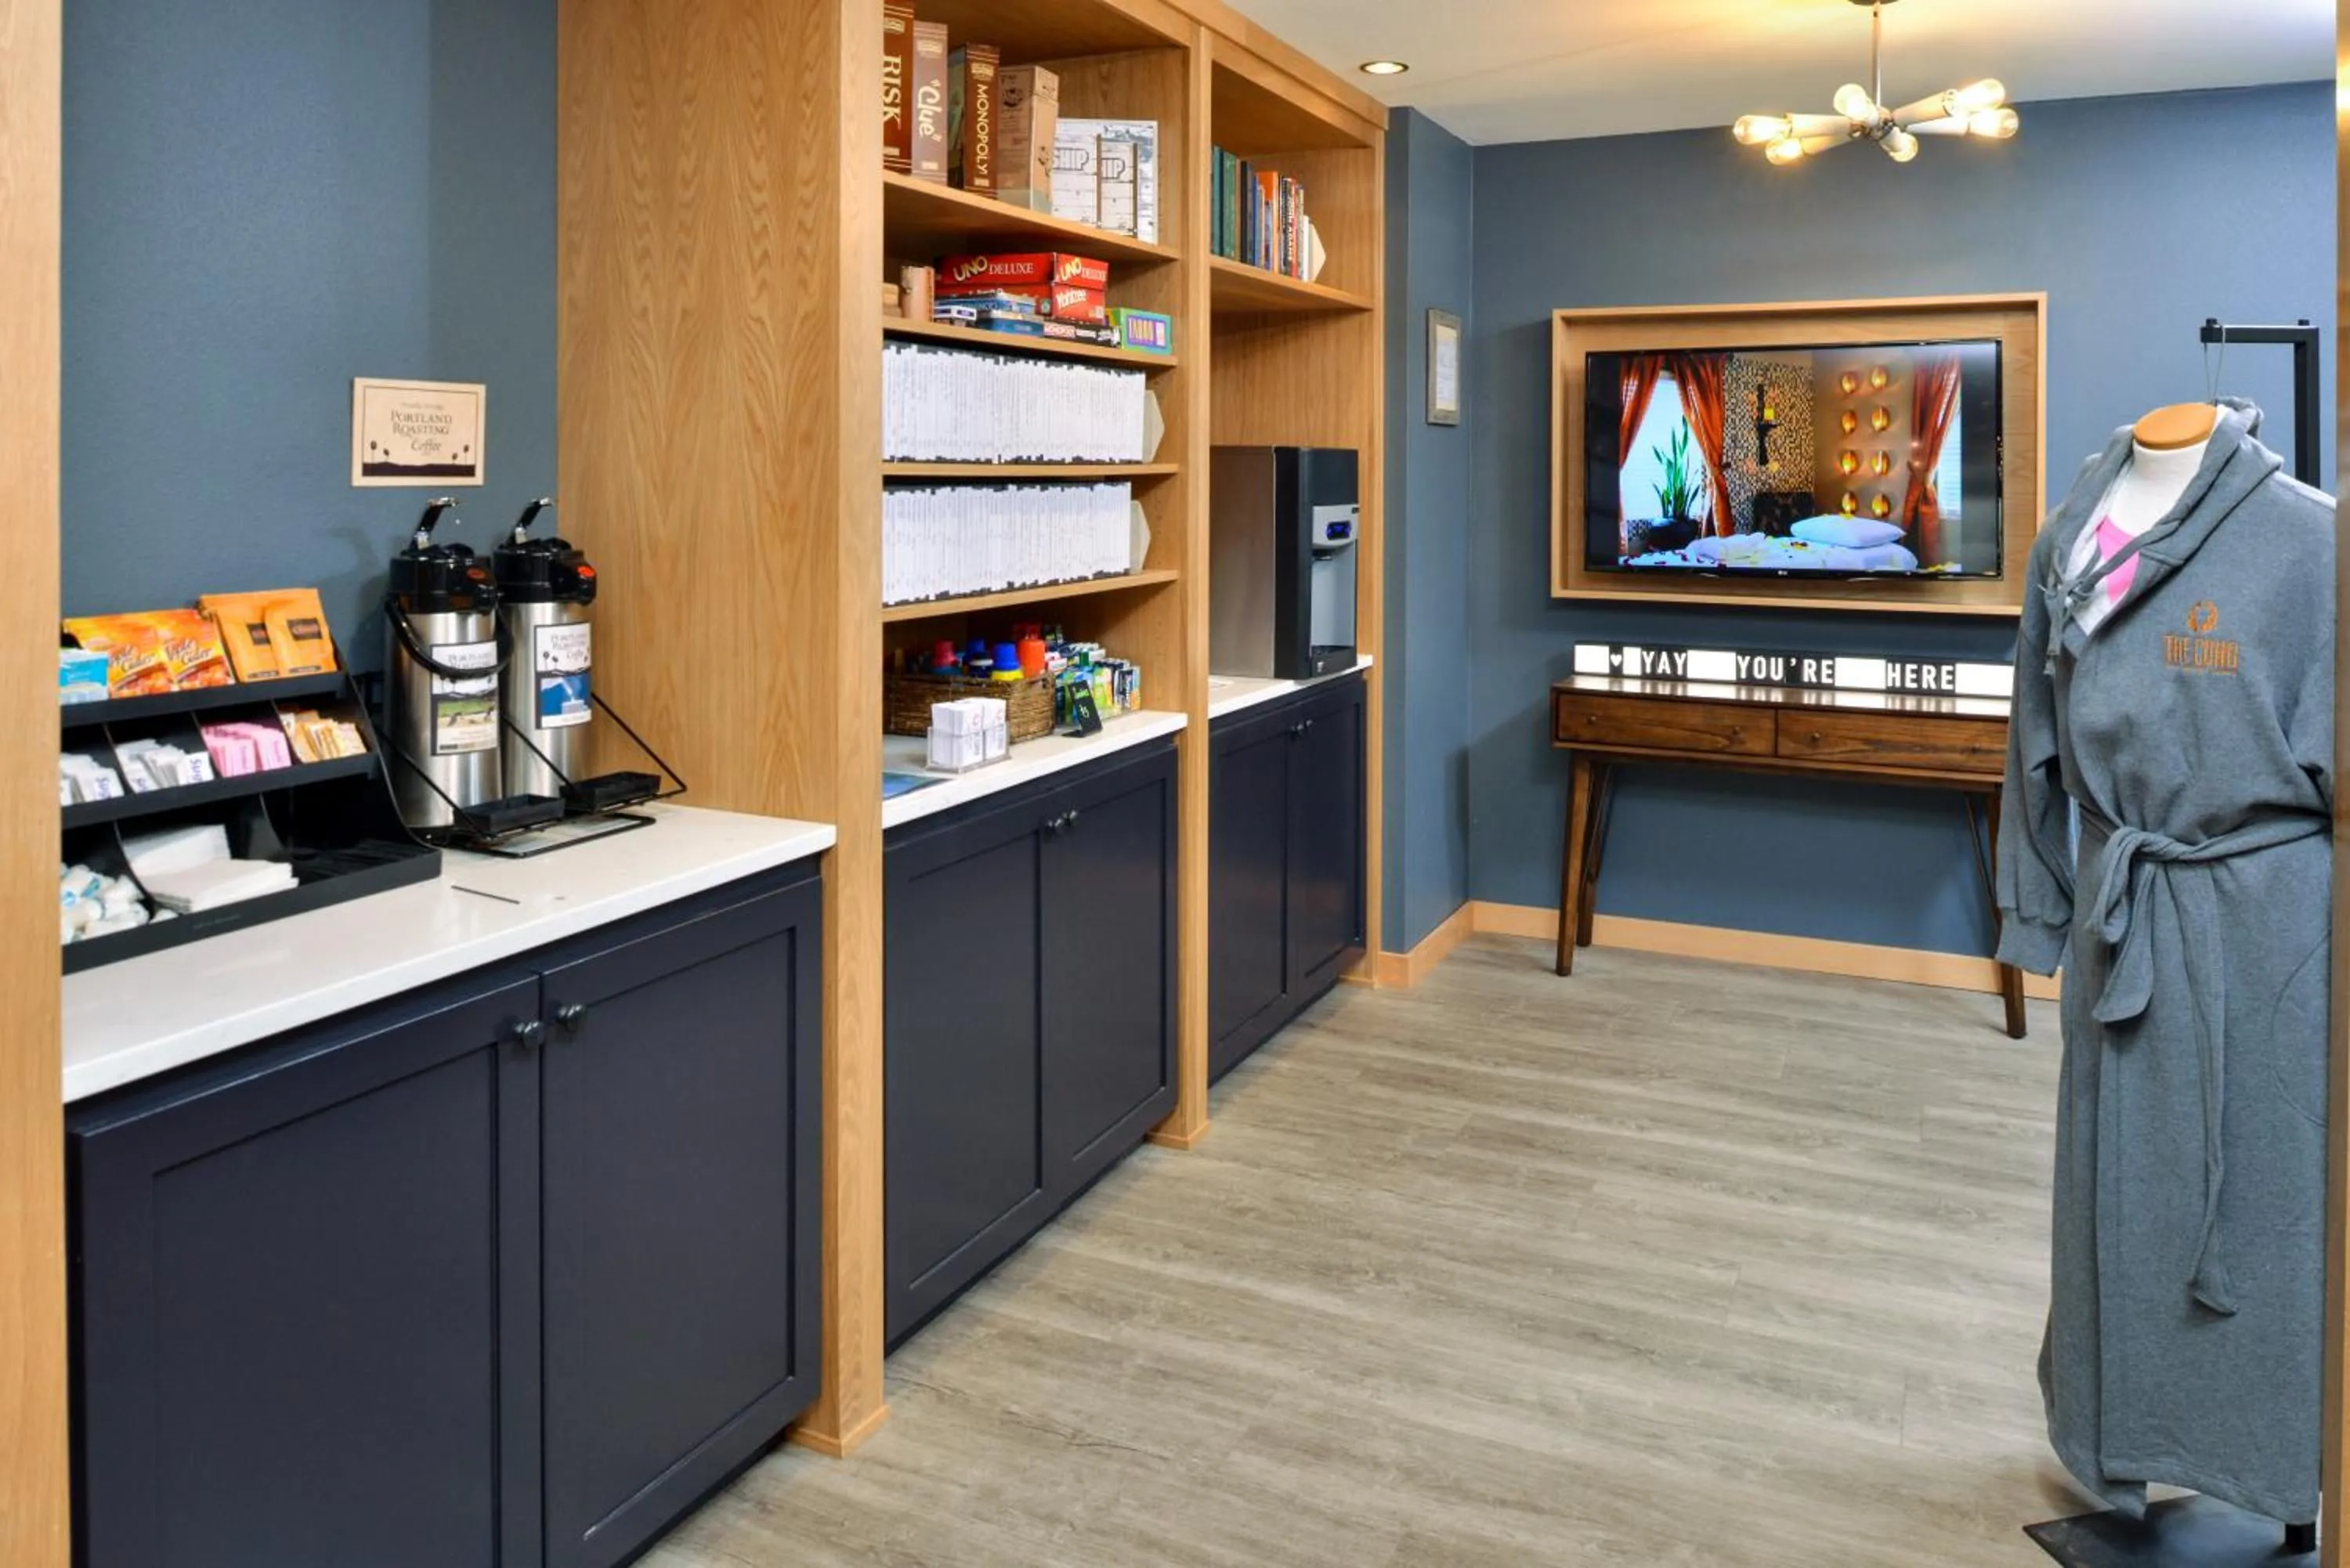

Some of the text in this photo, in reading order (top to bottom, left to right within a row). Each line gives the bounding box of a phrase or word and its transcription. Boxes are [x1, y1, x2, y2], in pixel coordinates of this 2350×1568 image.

[883, 55, 902, 130] RISK
[976, 84, 989, 175] MONOPOLY
[953, 256, 1034, 282] UNO DELUXE
[1059, 257, 1082, 282] UNO
[391, 410, 452, 425] PORTLAND
[392, 422, 450, 436] ROASTING
[410, 439, 441, 456] Coffee
[2162, 634, 2191, 664] THE
[1642, 651, 1955, 690] YAY YOU'RE HERE
